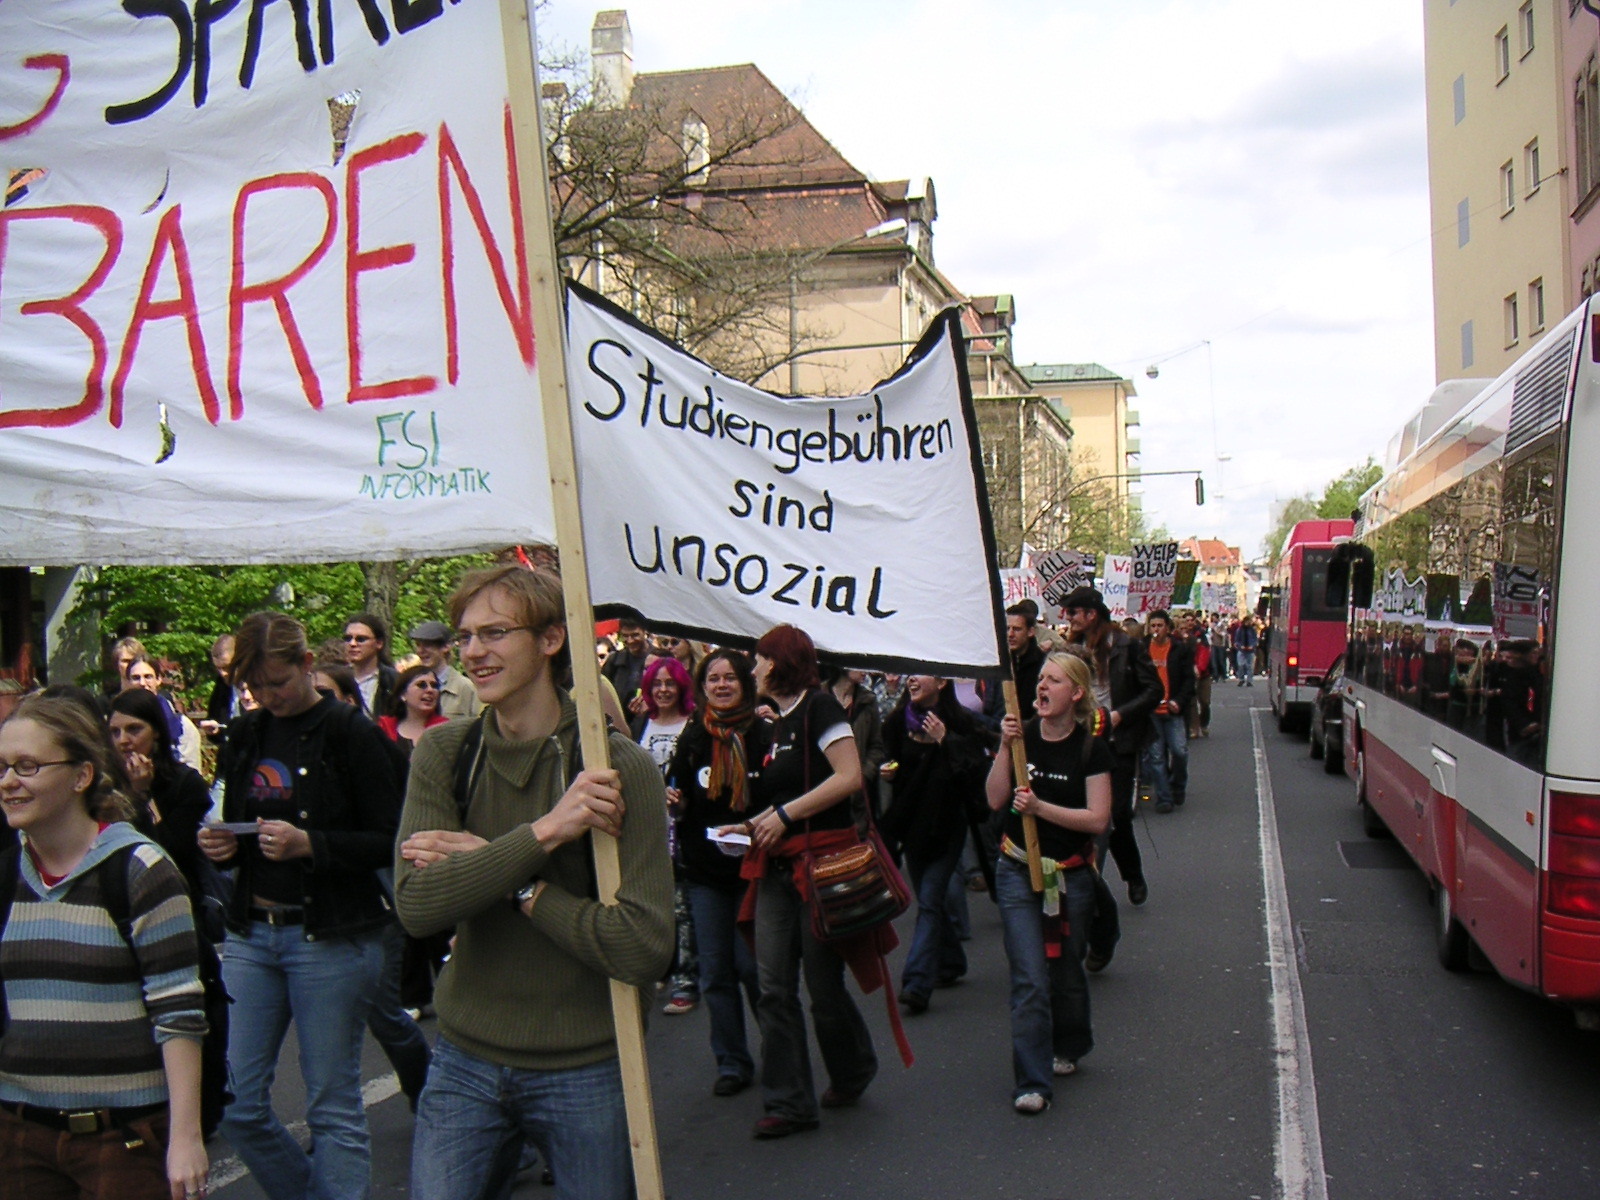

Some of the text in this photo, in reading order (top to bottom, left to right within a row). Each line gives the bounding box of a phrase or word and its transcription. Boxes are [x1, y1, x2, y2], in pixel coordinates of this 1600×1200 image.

[584, 339, 953, 474] Studiengebühren
[376, 410, 440, 470] FSI
[728, 479, 834, 533] sind
[1036, 552, 1075, 582] KILL
[1113, 559, 1131, 573] Wi
[1133, 561, 1175, 579] BLAU
[1041, 567, 1087, 607] BILDUNG
